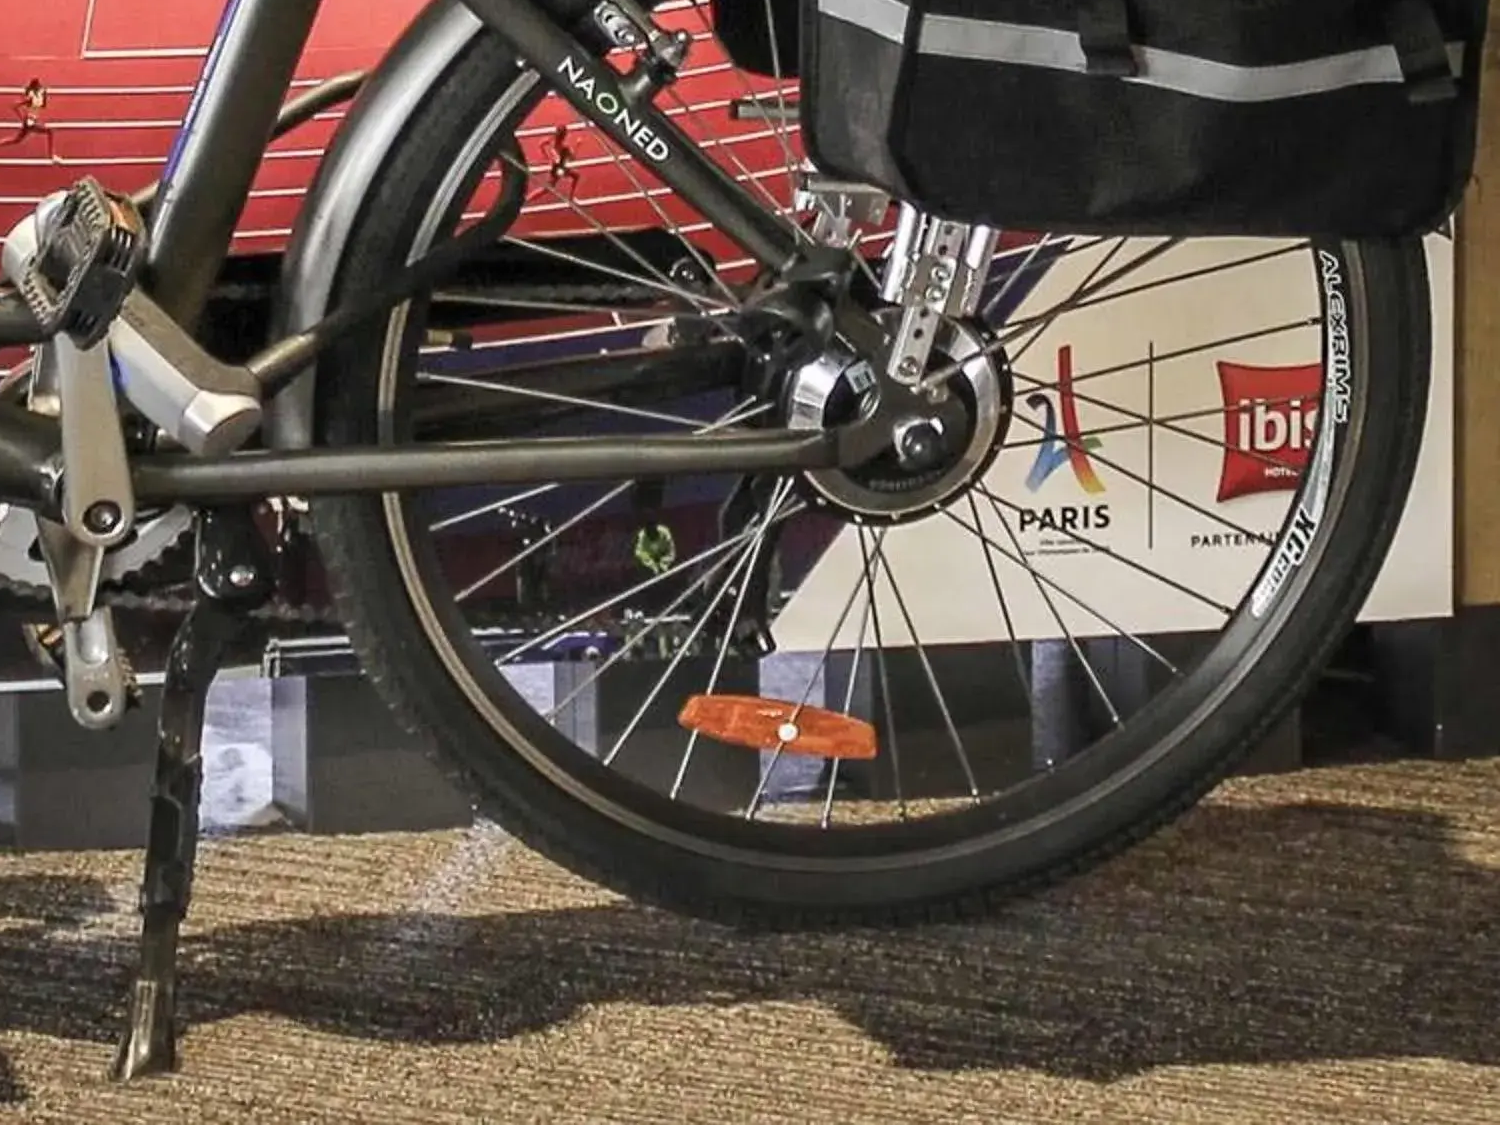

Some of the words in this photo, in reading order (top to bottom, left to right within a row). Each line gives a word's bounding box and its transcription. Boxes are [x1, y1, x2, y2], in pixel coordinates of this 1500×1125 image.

[557, 55, 669, 162] NAONED
[1319, 250, 1352, 424] ALEXRIMS
[1019, 504, 1111, 532] PARIS
